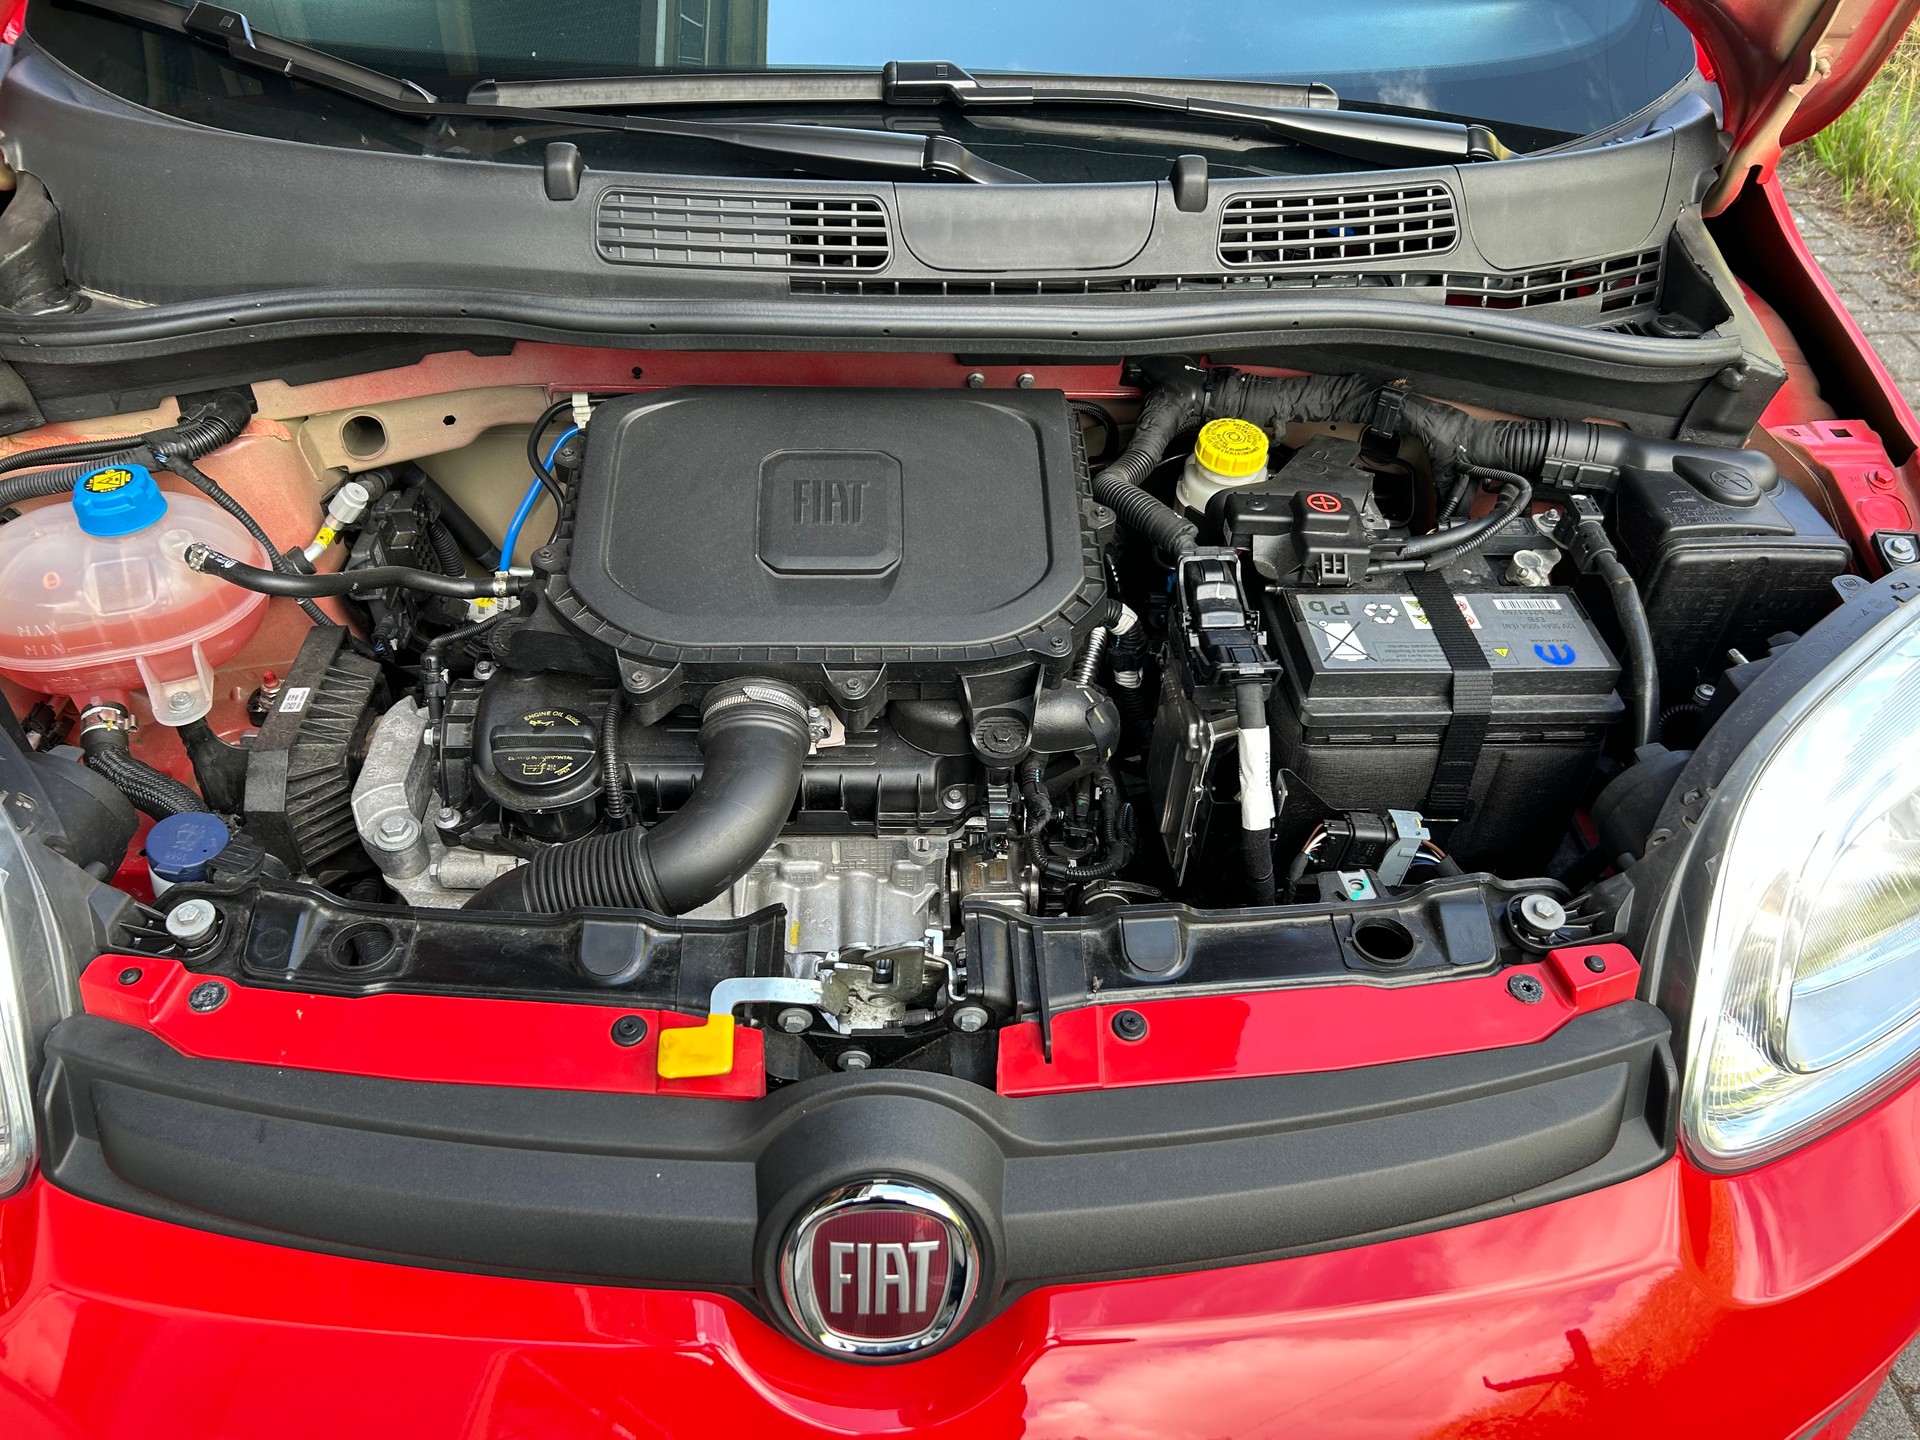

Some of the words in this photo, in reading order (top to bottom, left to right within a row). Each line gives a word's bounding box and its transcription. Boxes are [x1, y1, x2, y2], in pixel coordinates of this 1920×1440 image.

[793, 479, 870, 526] FIAT
[1308, 600, 1350, 616] Pb
[17, 624, 58, 637] MAX
[1562, 622, 1576, 630] 12V
[24, 643, 66, 656] MIN
[523, 710, 552, 721] ENGINE
[552, 710, 564, 718] OIL
[829, 1240, 940, 1315] FIAT
